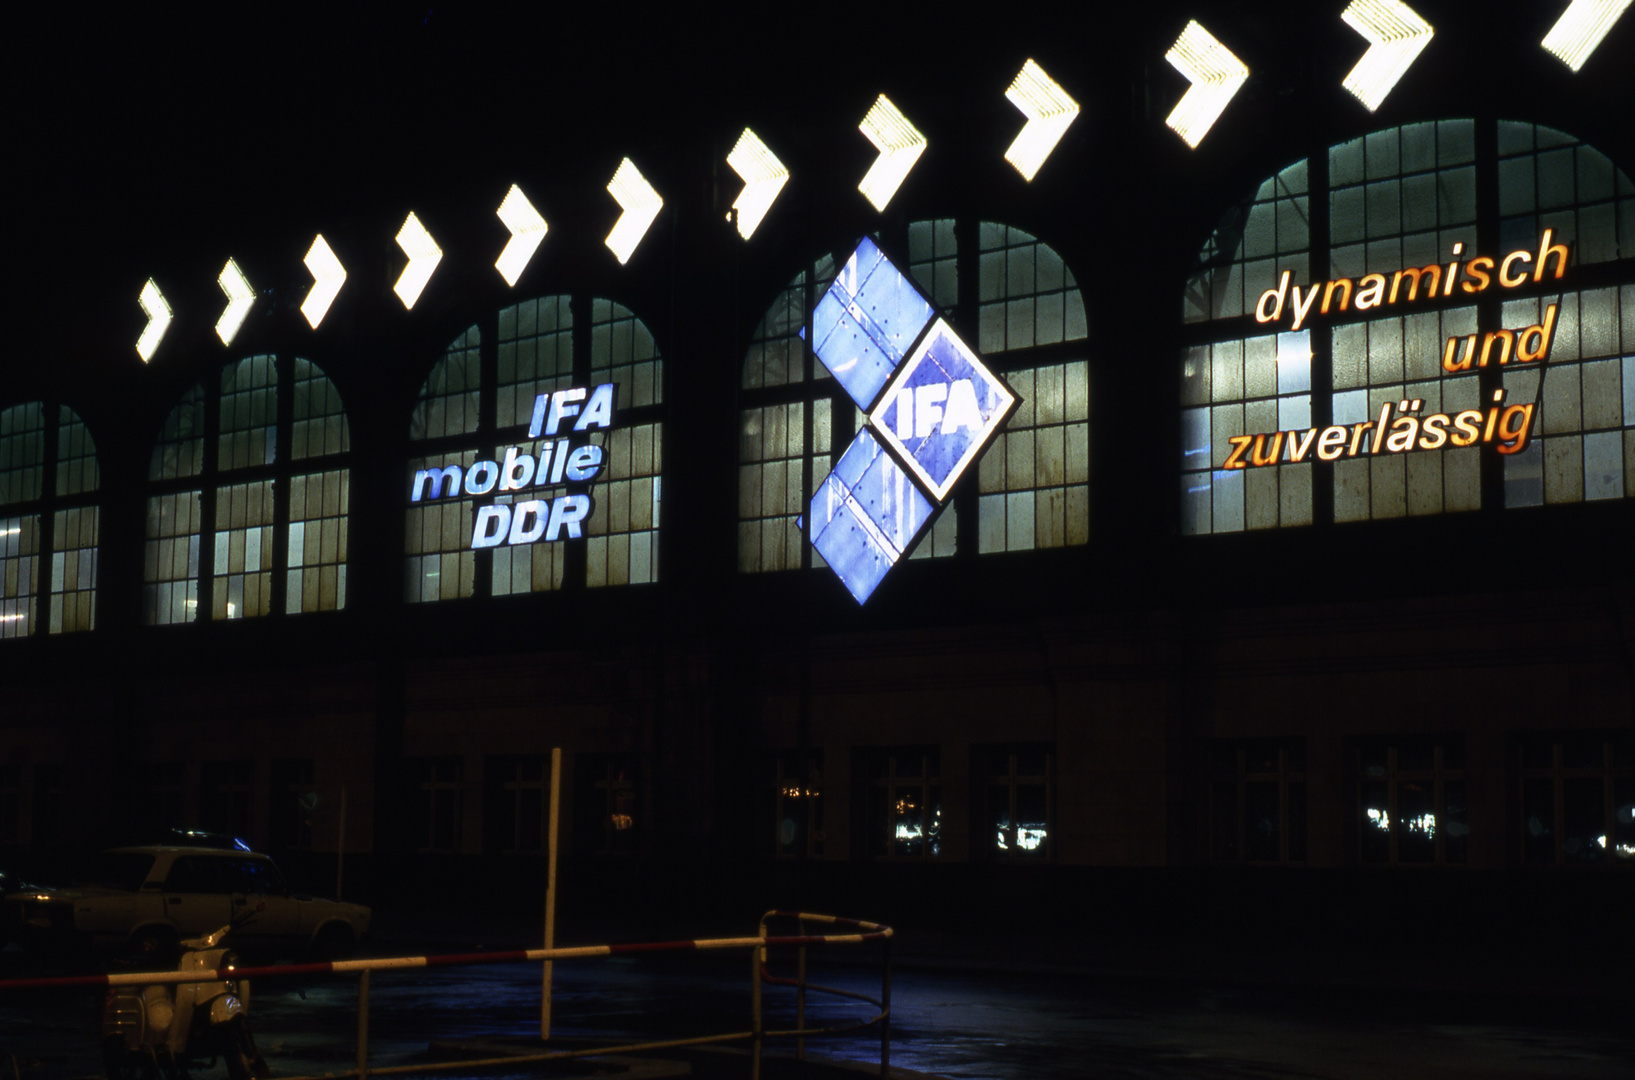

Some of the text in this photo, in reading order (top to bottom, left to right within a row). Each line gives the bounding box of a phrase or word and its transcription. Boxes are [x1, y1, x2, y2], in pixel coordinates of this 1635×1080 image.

[1255, 228, 1569, 330] dynamisch
[1443, 304, 1557, 372] und
[528, 383, 614, 438] IFA
[895, 379, 984, 441] IFA
[1223, 389, 1534, 469] zuverlässig
[411, 439, 602, 502] mobile
[471, 494, 590, 549] DDR
